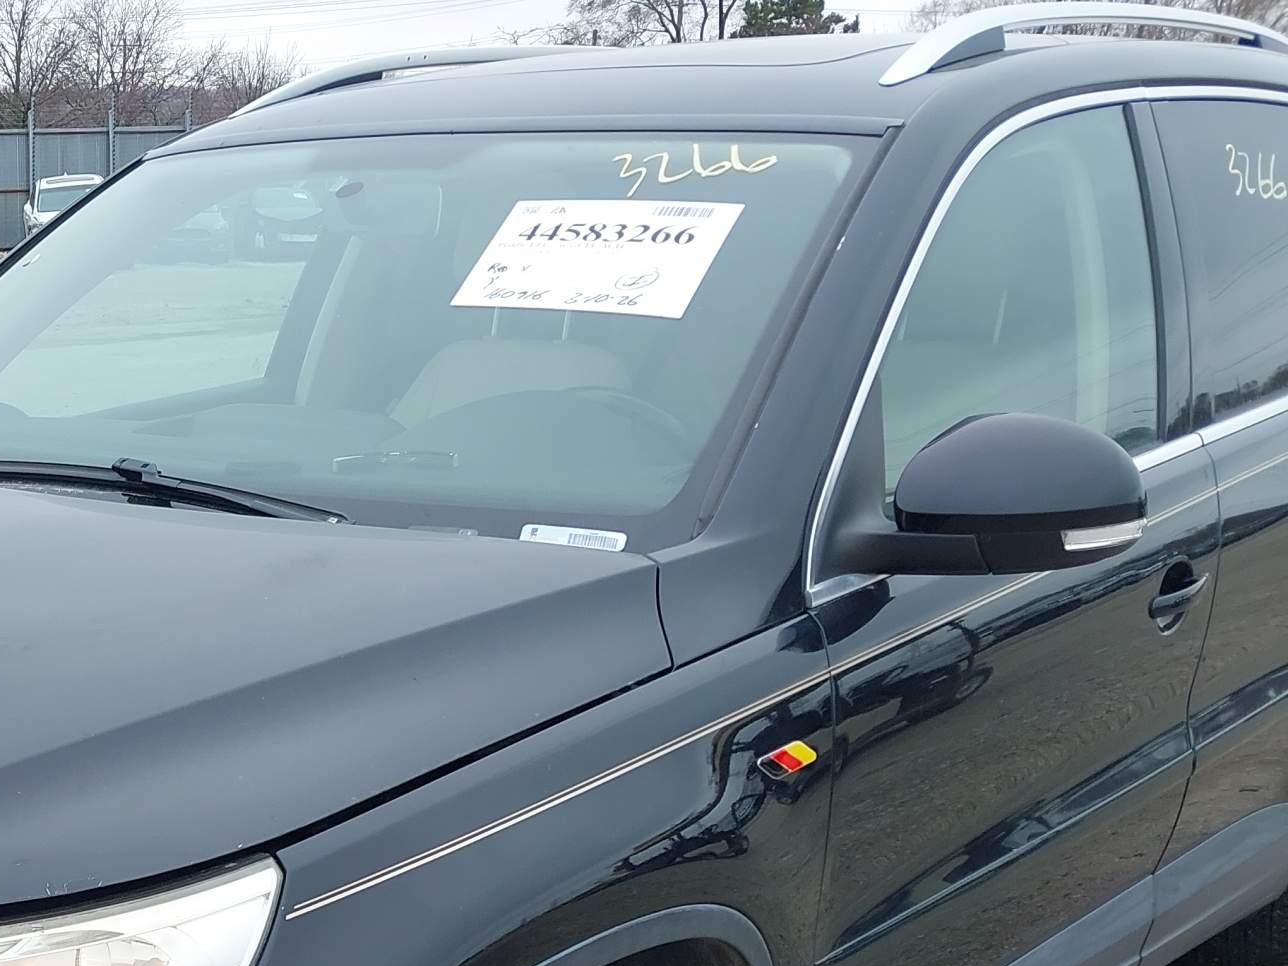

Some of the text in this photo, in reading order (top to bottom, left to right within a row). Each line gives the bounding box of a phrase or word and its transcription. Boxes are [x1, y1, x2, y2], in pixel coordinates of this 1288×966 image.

[612, 143, 778, 197] 3266
[1225, 143, 1287, 199] 3266
[518, 222, 698, 245] 44583266
